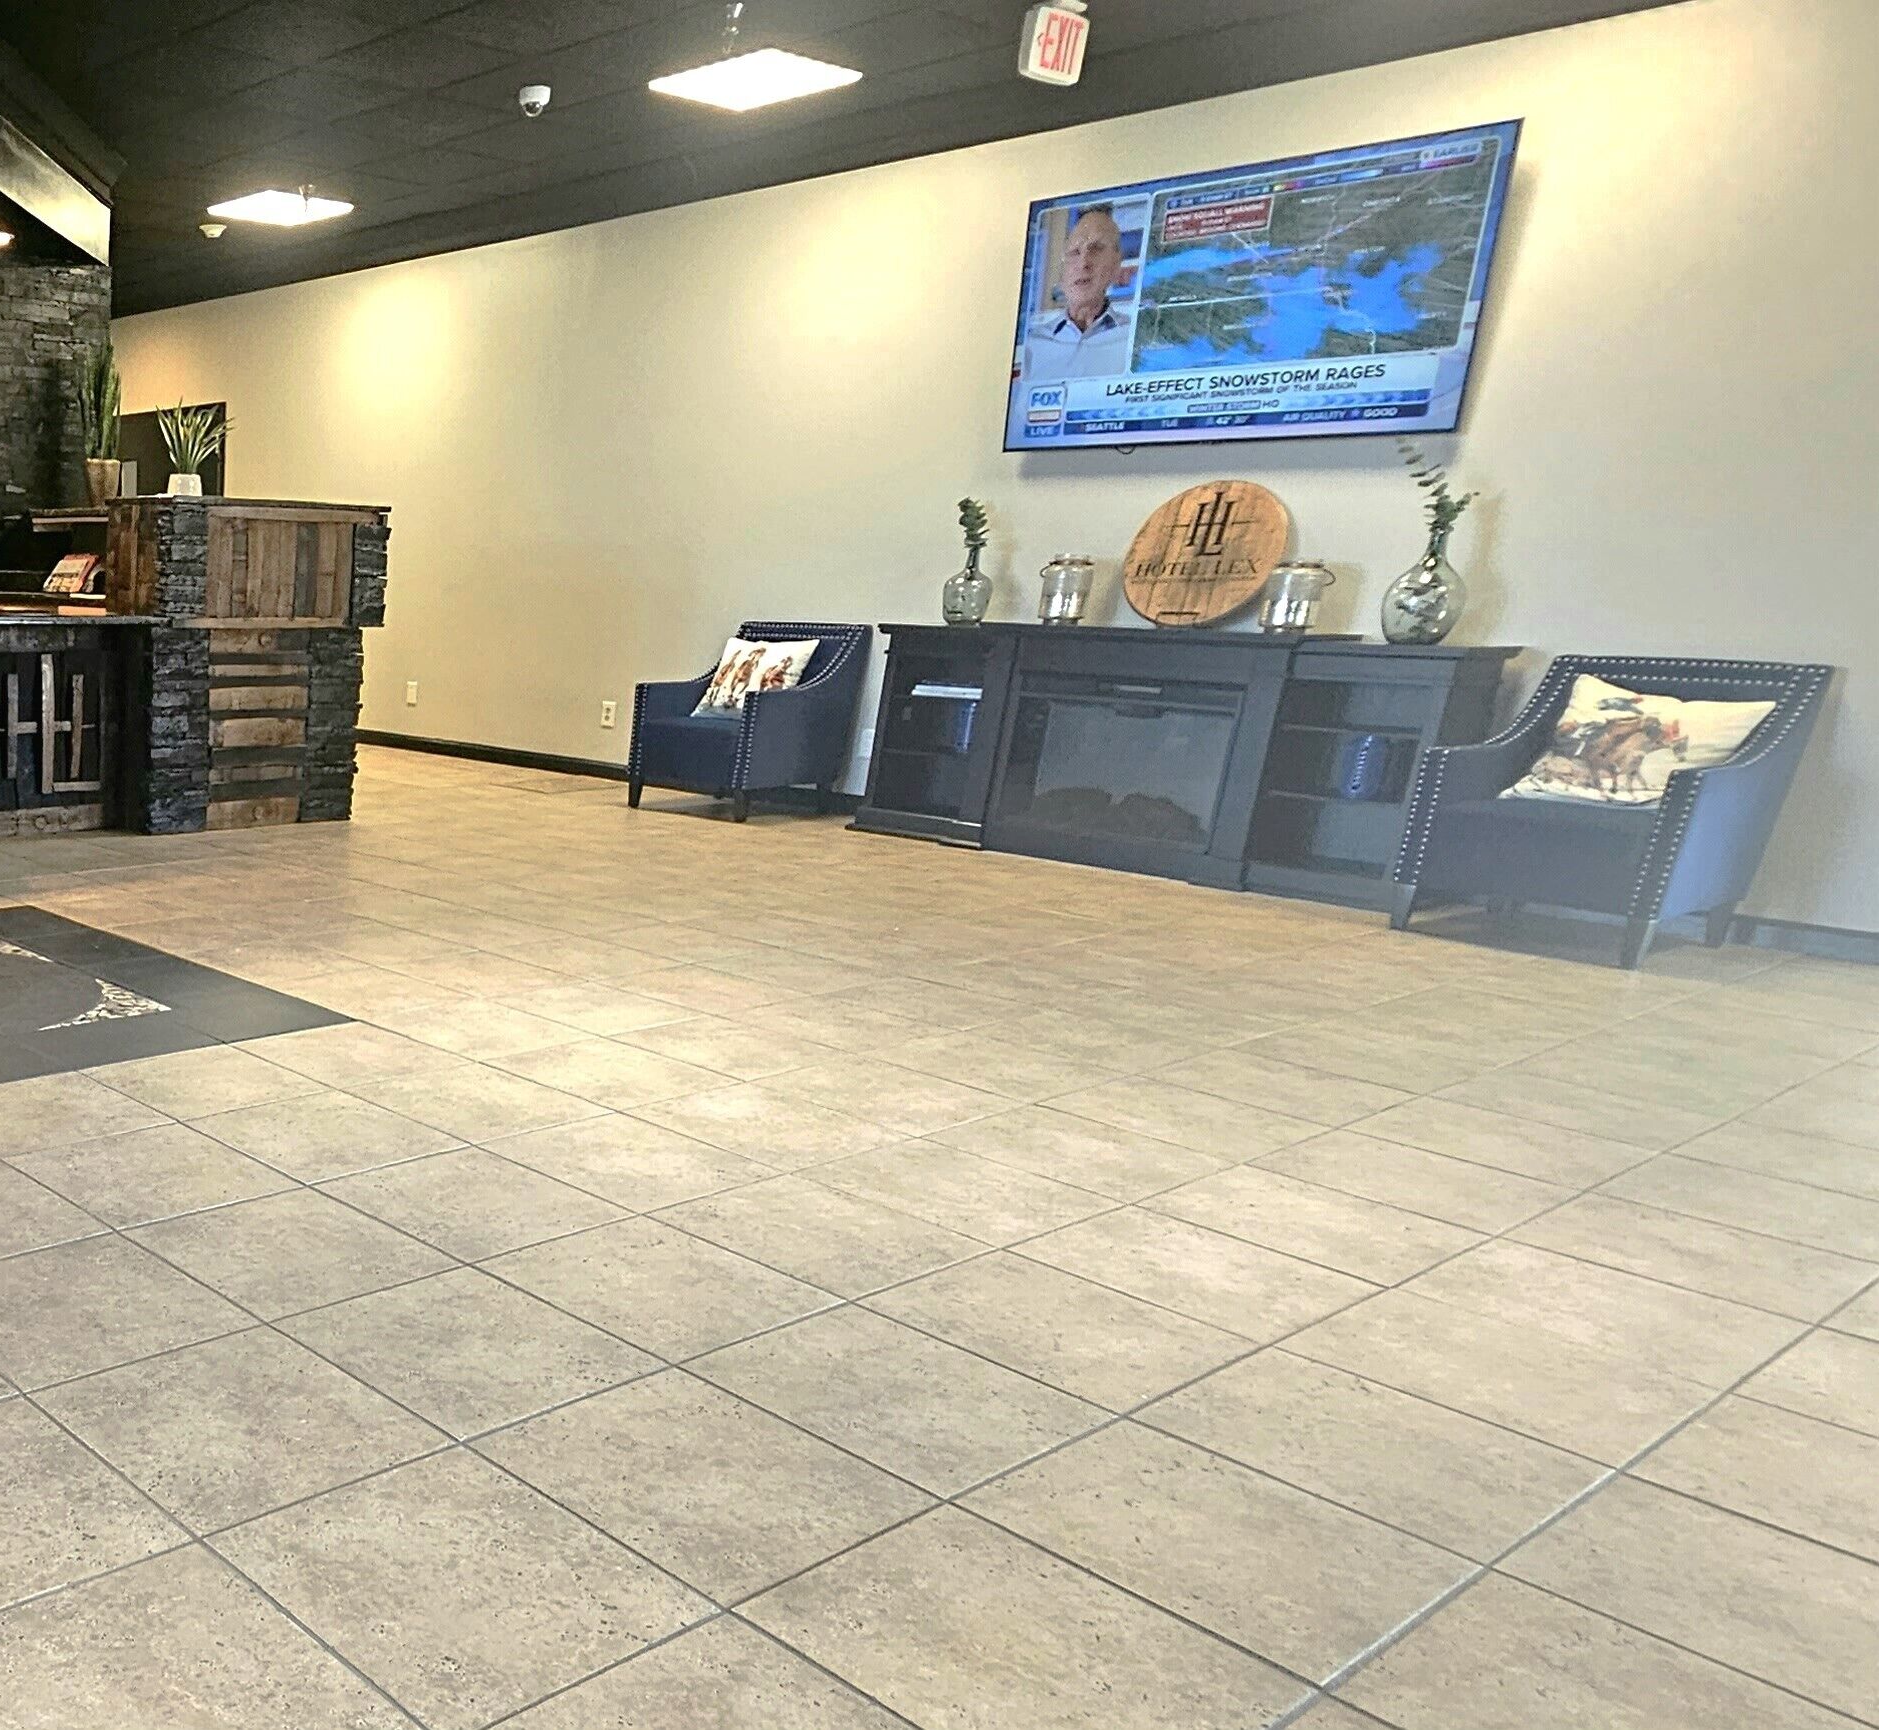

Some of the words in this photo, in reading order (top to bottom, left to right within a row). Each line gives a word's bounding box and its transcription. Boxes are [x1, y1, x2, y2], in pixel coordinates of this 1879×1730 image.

[1039, 12, 1085, 75] EXIT
[1106, 376, 1205, 397] LAKE-EFFECT
[1208, 367, 1321, 390] SNOWSTORM
[1325, 363, 1387, 382] RAGES
[1030, 389, 1063, 408] FOX
[1125, 395, 1150, 404] FIRST
[1151, 390, 1208, 403] SIGNIFICANT
[1210, 385, 1274, 399] SNOWSTORM
[1276, 384, 1291, 395] OF
[1294, 383, 1312, 393] THE
[1315, 380, 1359, 392] SEASON
[1282, 412, 1300, 423] AIR
[1302, 409, 1347, 422] QUALITY
[1363, 406, 1398, 418] GOOD
[1030, 426, 1054, 437] LIVE
[1084, 421, 1125, 433] SEATTLE
[1134, 562, 1201, 578] HOTEL
[1213, 559, 1260, 576] LEX
